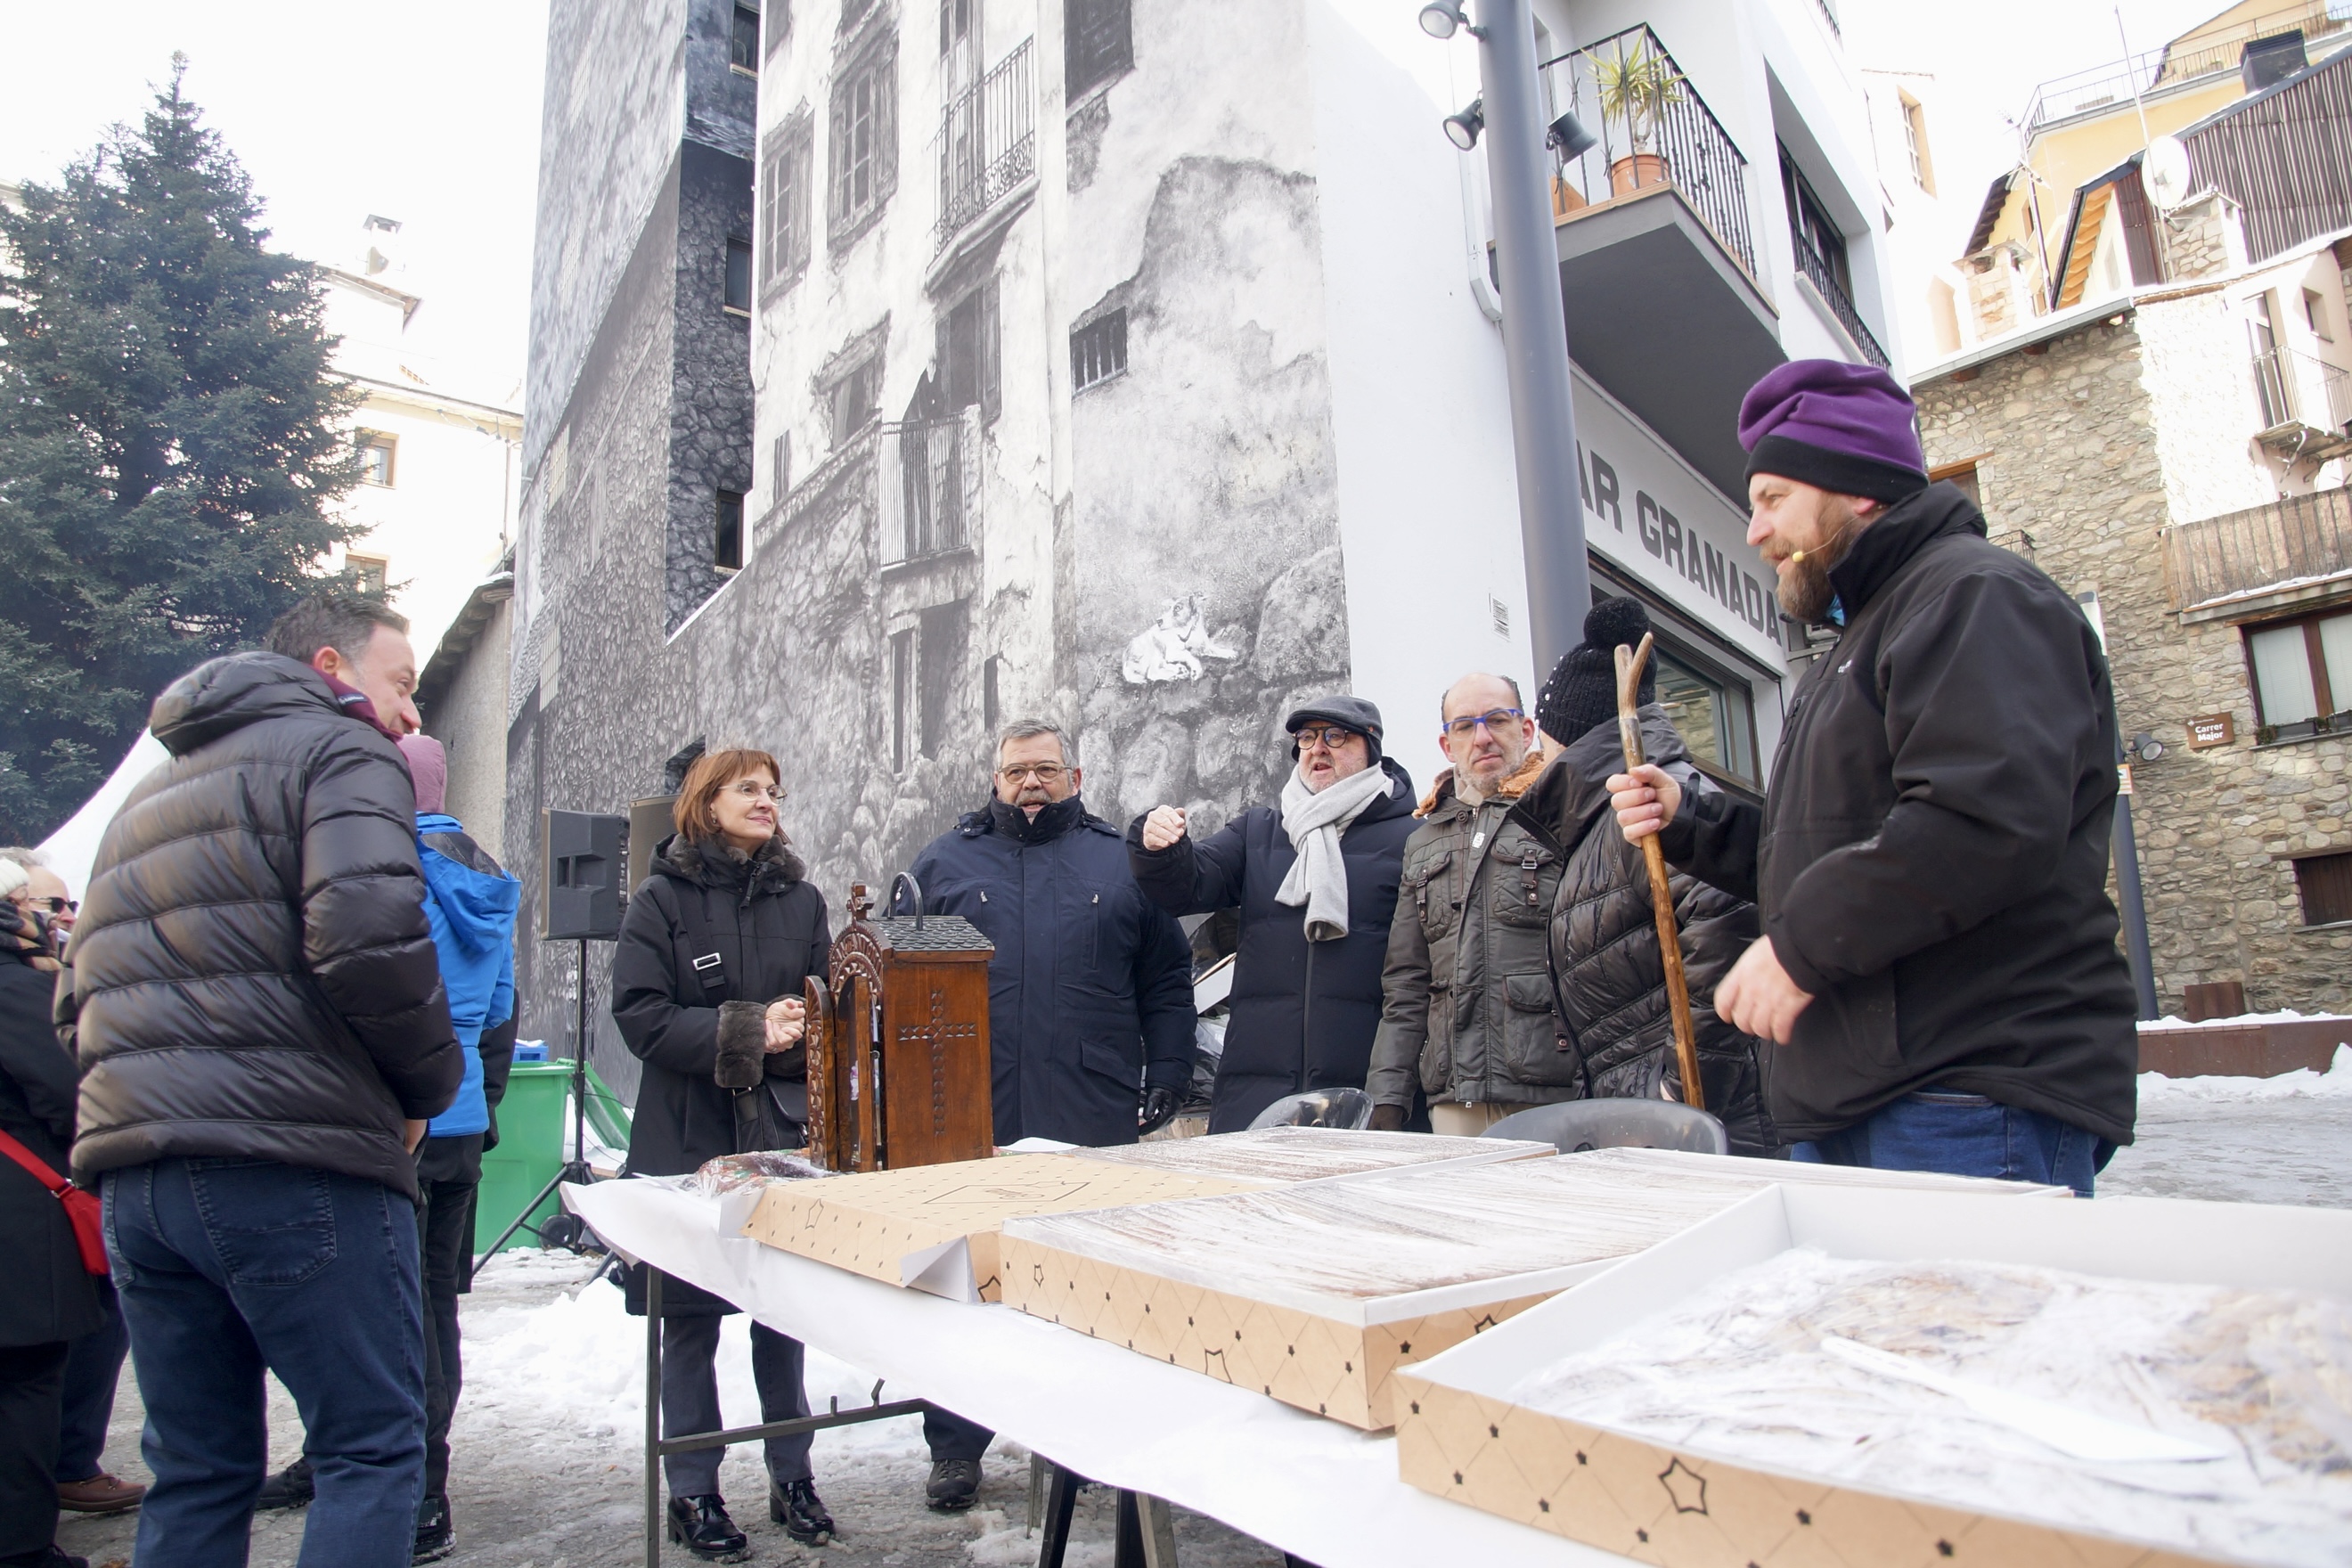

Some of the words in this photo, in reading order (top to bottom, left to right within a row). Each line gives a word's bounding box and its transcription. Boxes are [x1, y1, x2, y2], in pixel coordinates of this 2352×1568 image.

[1636, 489, 1783, 648] GRANADA
[2195, 723, 2224, 733] Carrer
[2197, 731, 2224, 741] Major
